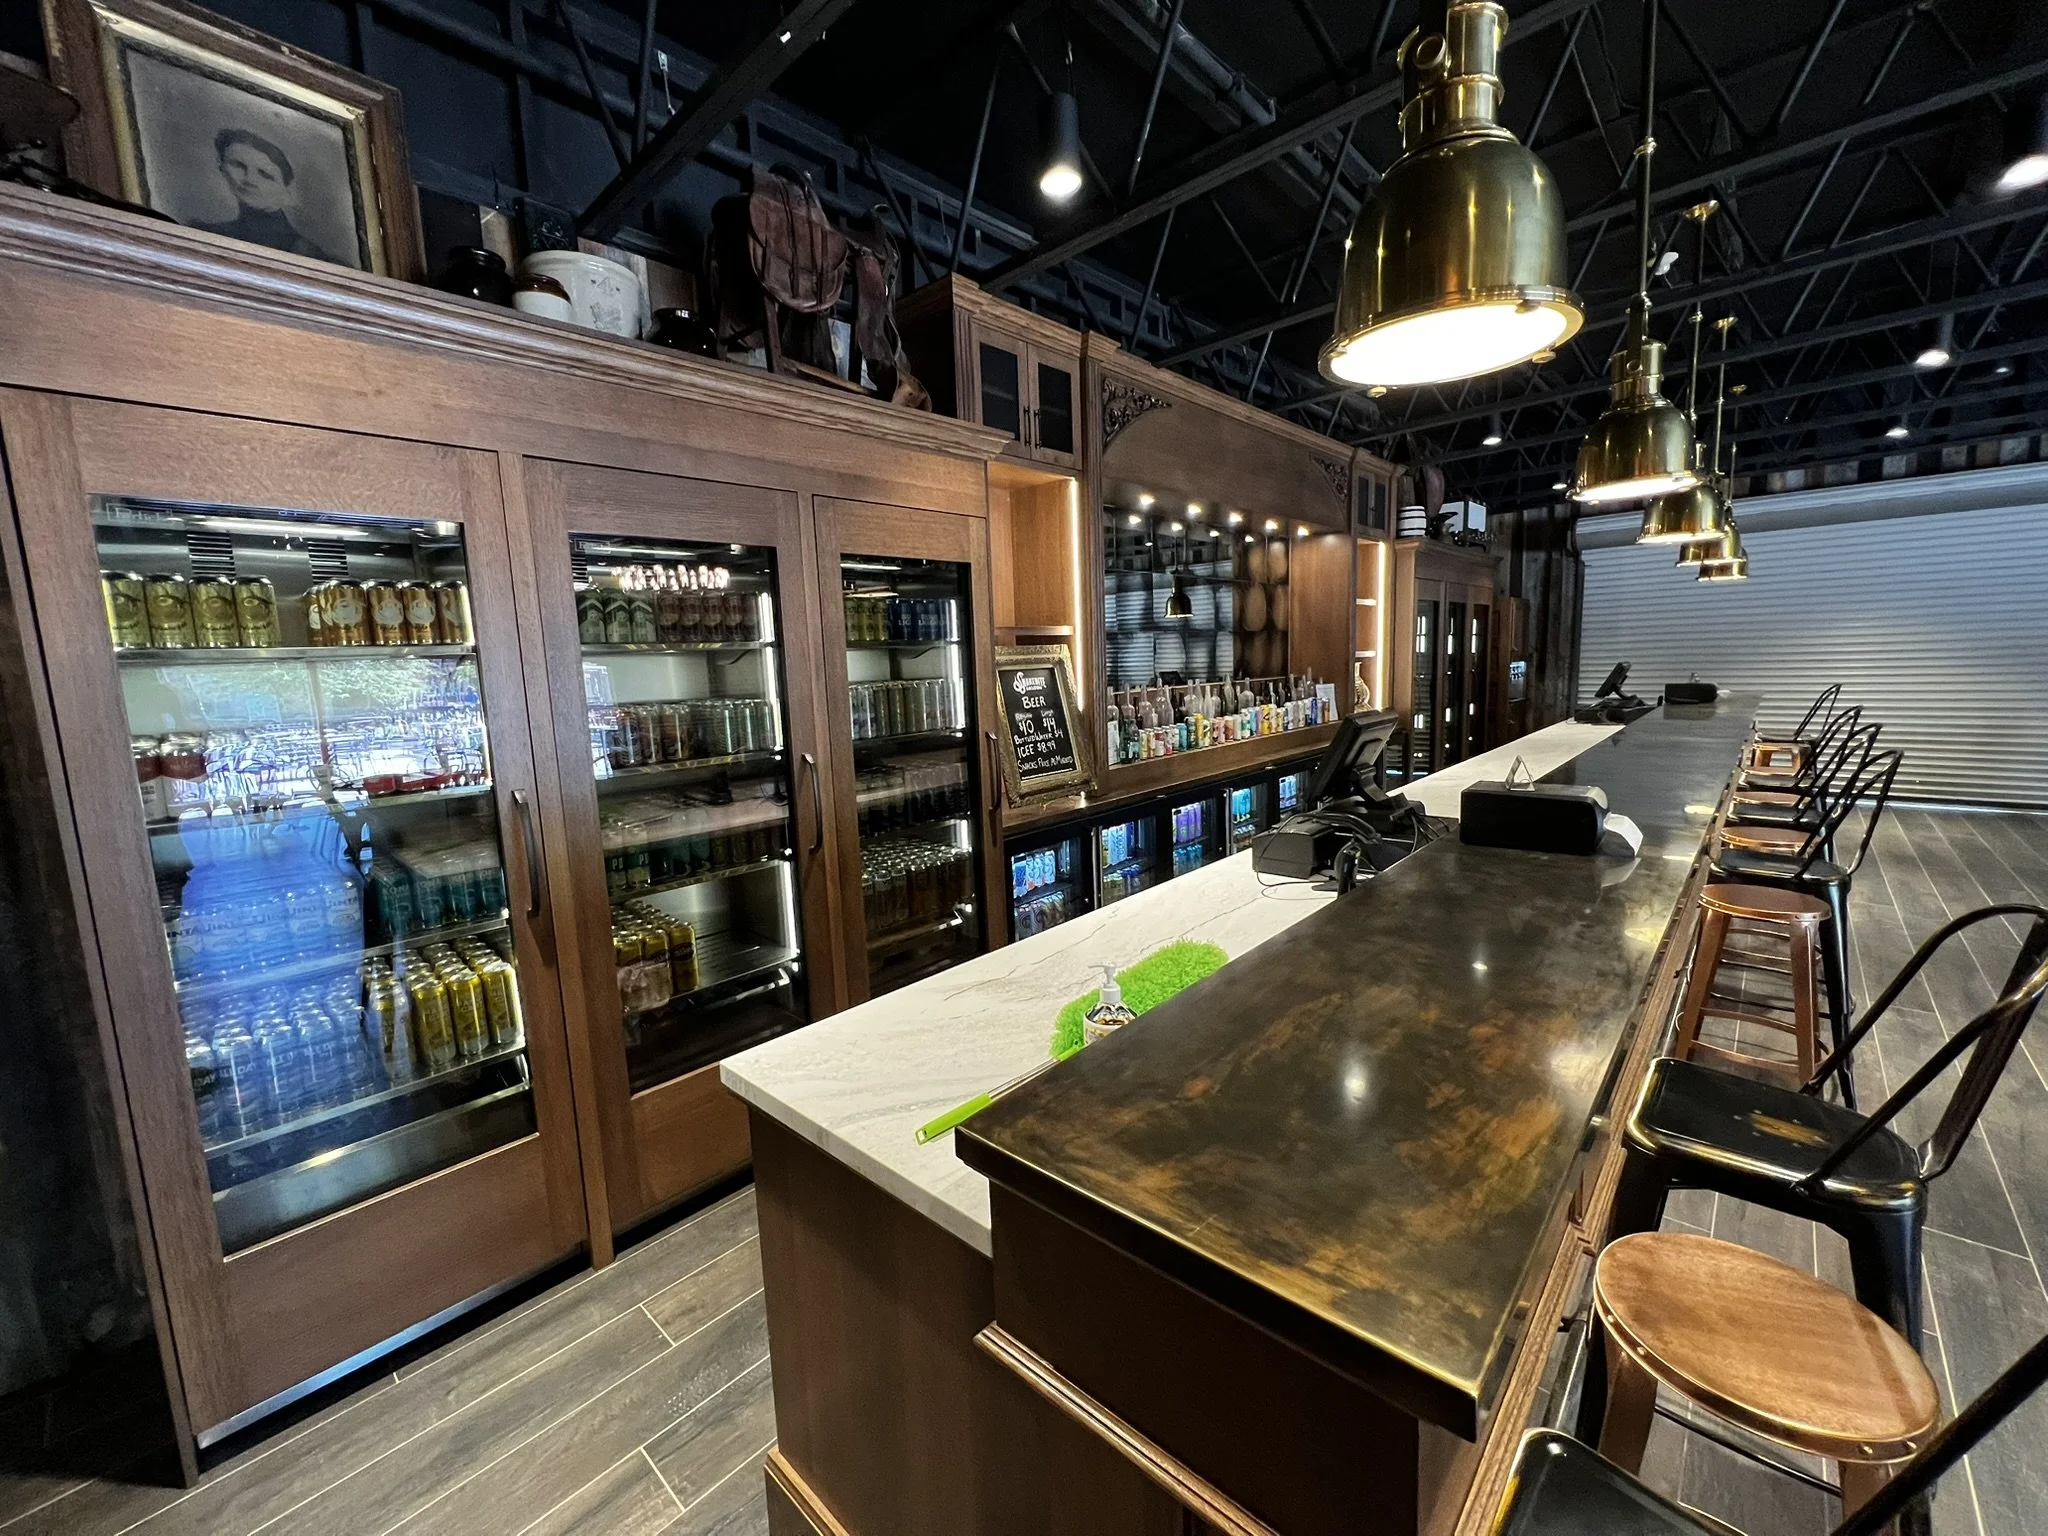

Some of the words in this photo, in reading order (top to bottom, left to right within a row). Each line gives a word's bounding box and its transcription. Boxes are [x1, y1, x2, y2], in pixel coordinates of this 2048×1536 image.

[1021, 696, 1046, 709] BEER
[1018, 719, 1034, 736] $10
[1043, 717, 1057, 732] $14
[1054, 728, 1064, 738] $4
[1017, 743, 1035, 758] ICEE
[1037, 740, 1056, 753] $8.99
